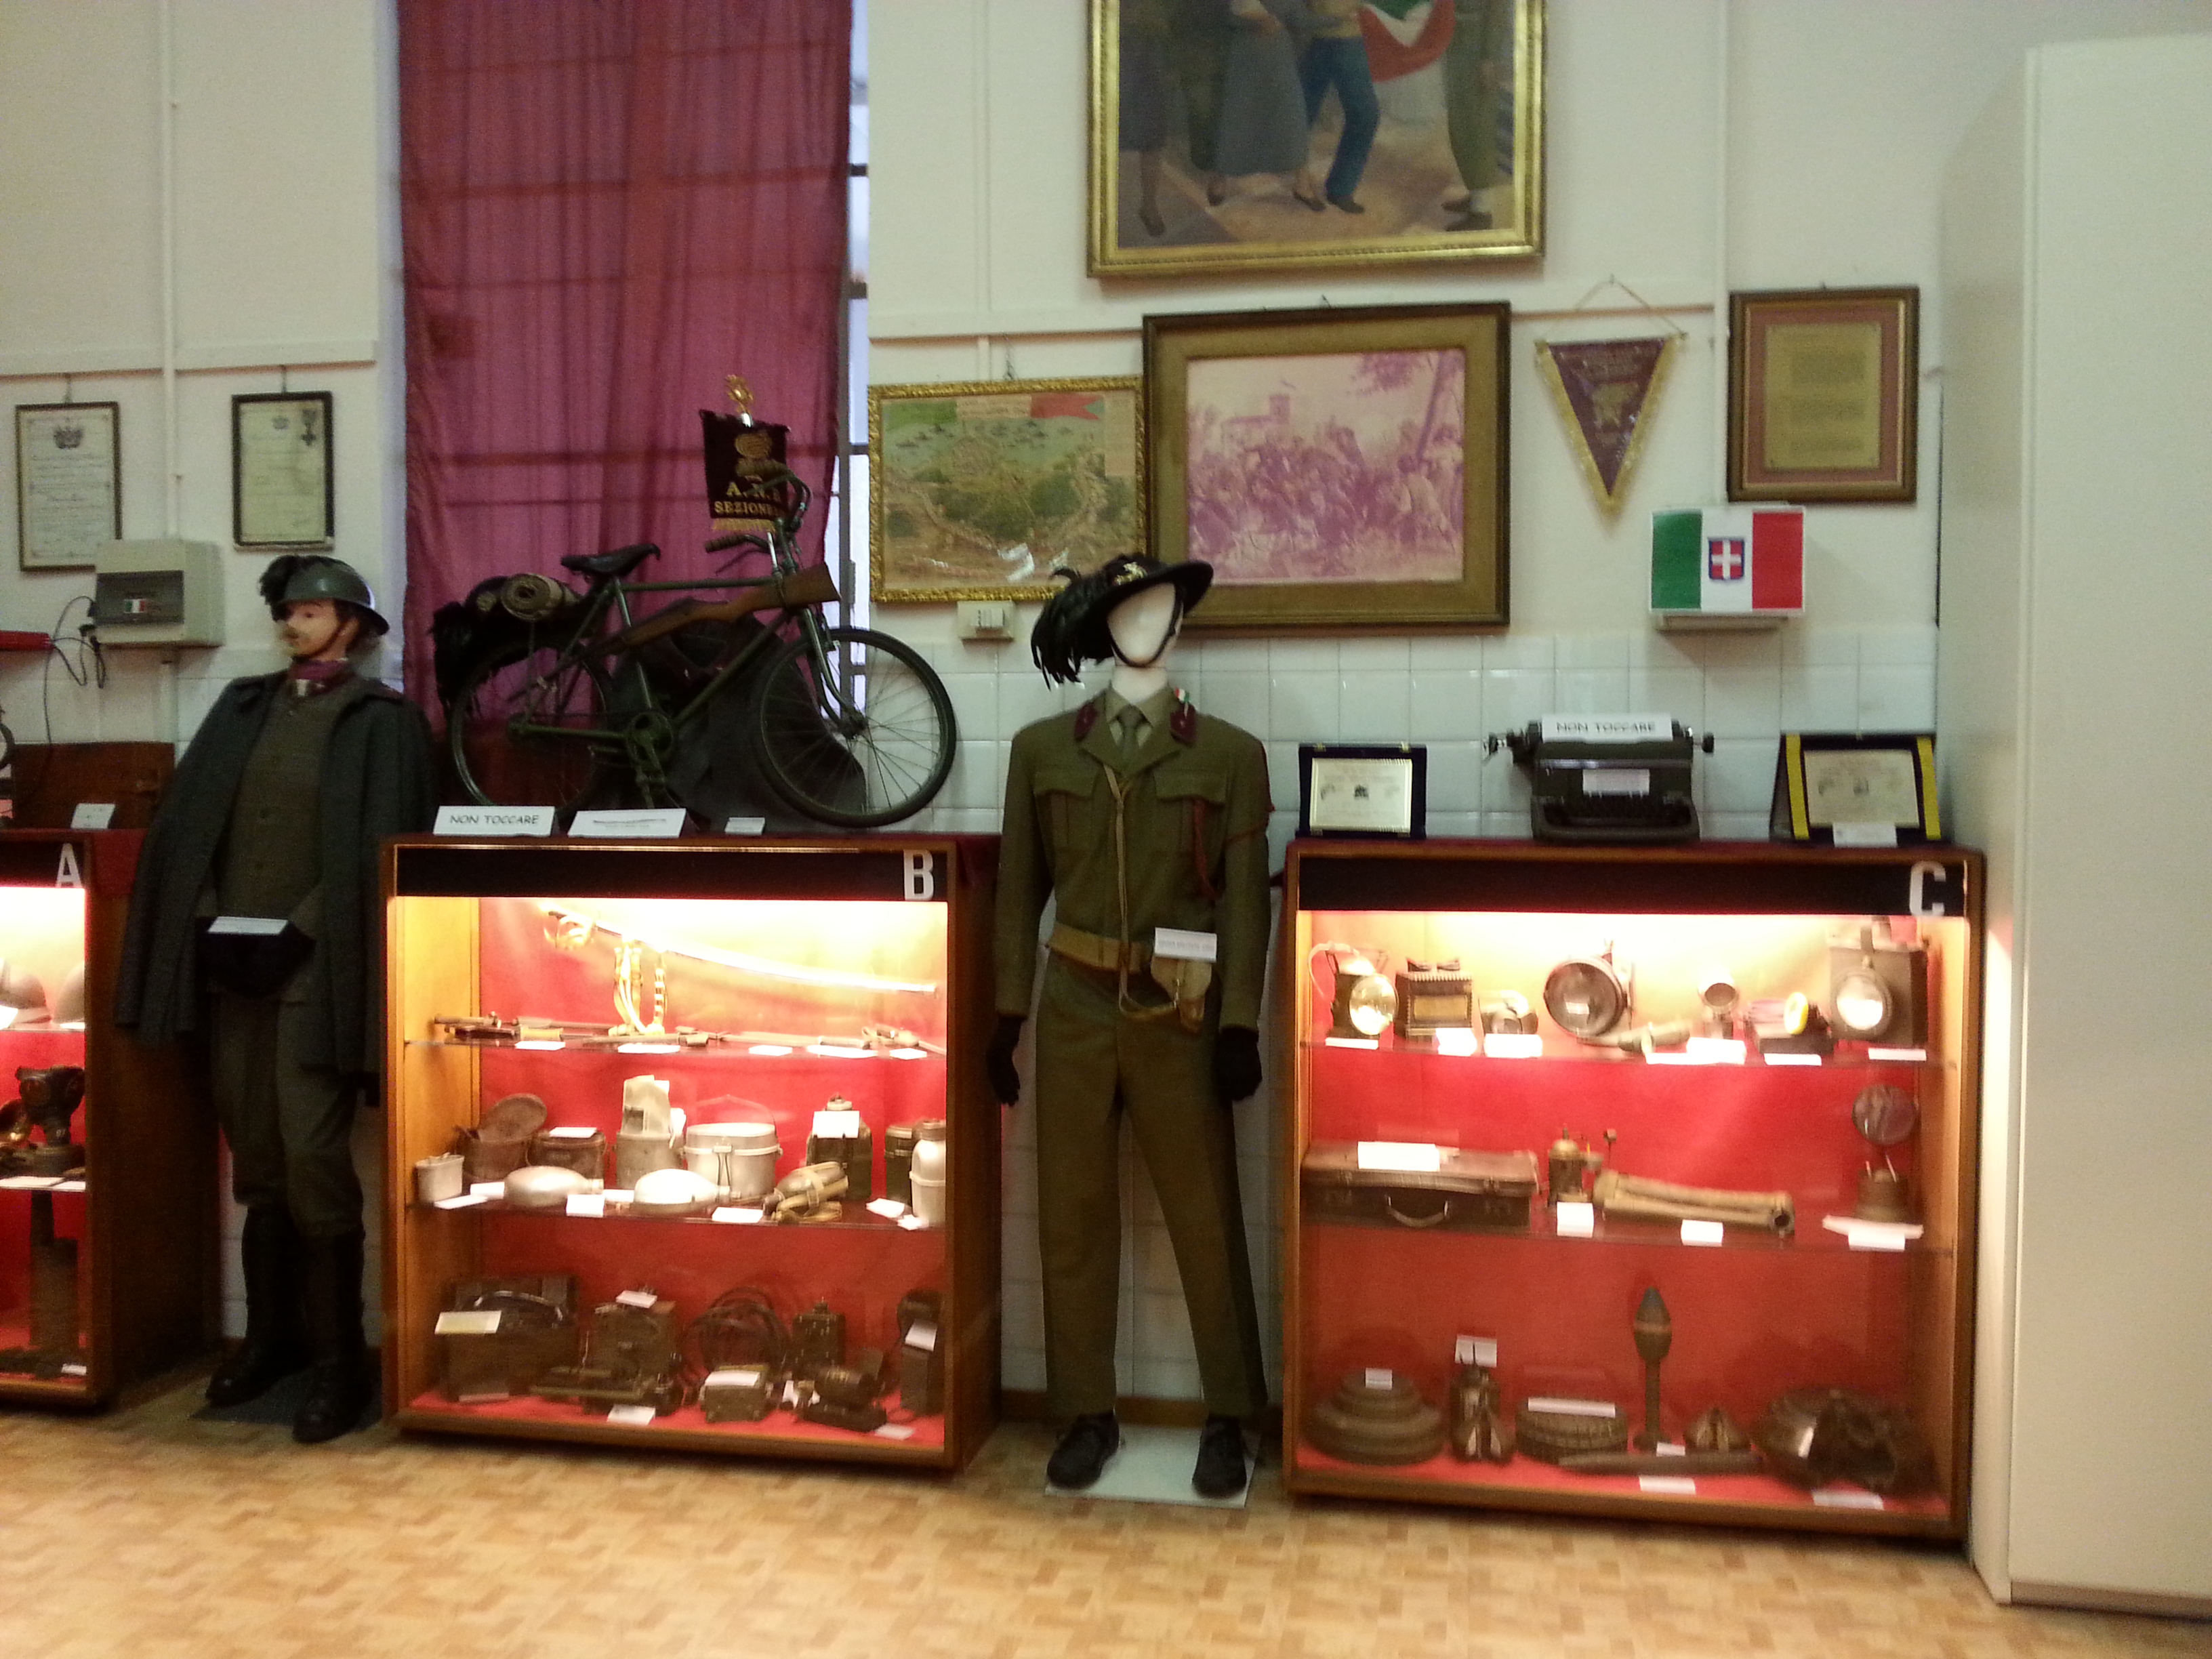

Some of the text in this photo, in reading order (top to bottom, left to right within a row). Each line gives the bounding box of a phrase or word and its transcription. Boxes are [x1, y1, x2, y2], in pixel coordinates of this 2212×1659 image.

[1556, 721, 1655, 734] NON TOCCARE
[450, 815, 539, 824] NON TOCCARE
[56, 842, 82, 888] A
[903, 848, 935, 901] B
[1909, 860, 1946, 917] C
